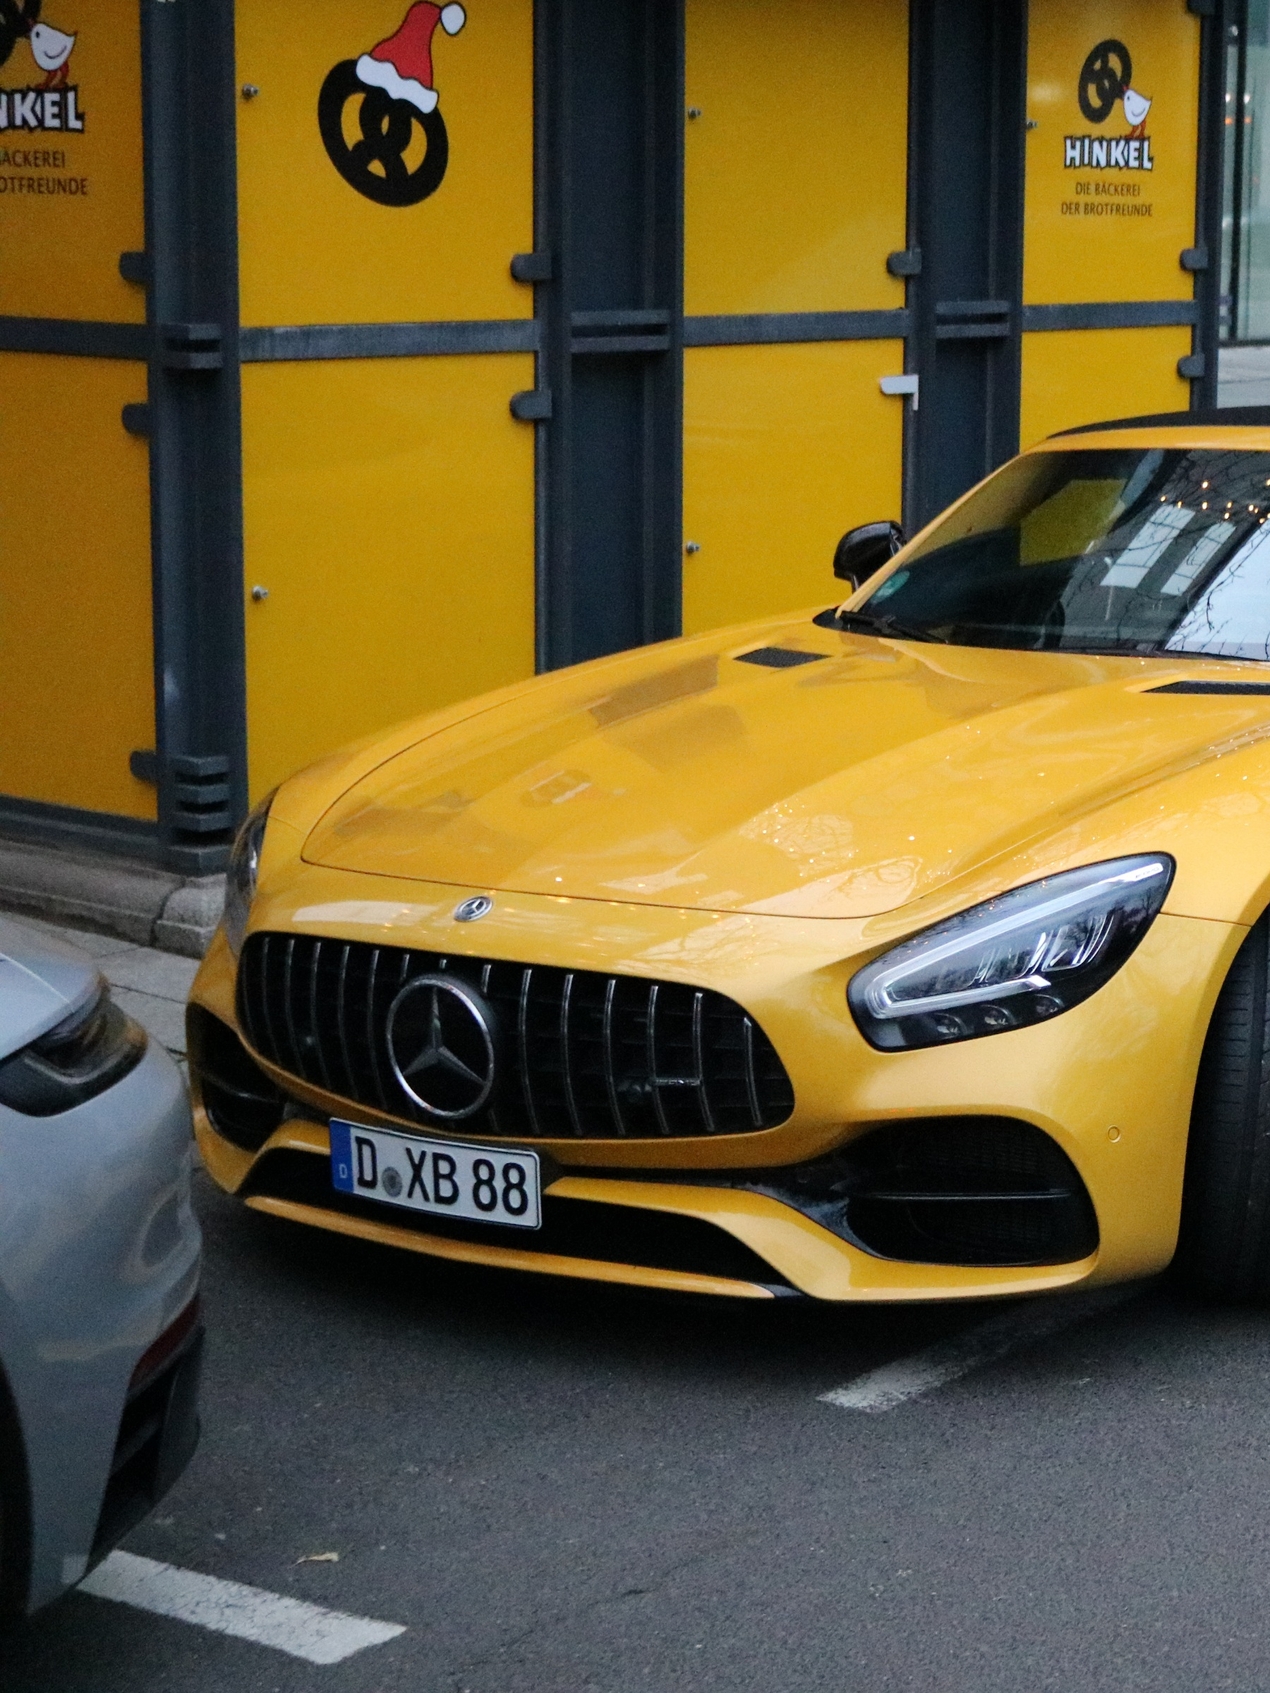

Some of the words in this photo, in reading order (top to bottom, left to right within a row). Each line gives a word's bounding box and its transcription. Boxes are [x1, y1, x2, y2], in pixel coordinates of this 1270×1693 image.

[1064, 136, 1153, 171] HINKEL
[1075, 182, 1091, 196] DIE
[1061, 202, 1080, 215] DER
[1084, 203, 1153, 217] BROTFREUNDE
[355, 1135, 378, 1189] D
[405, 1147, 460, 1206] XB
[472, 1158, 529, 1217] 88
